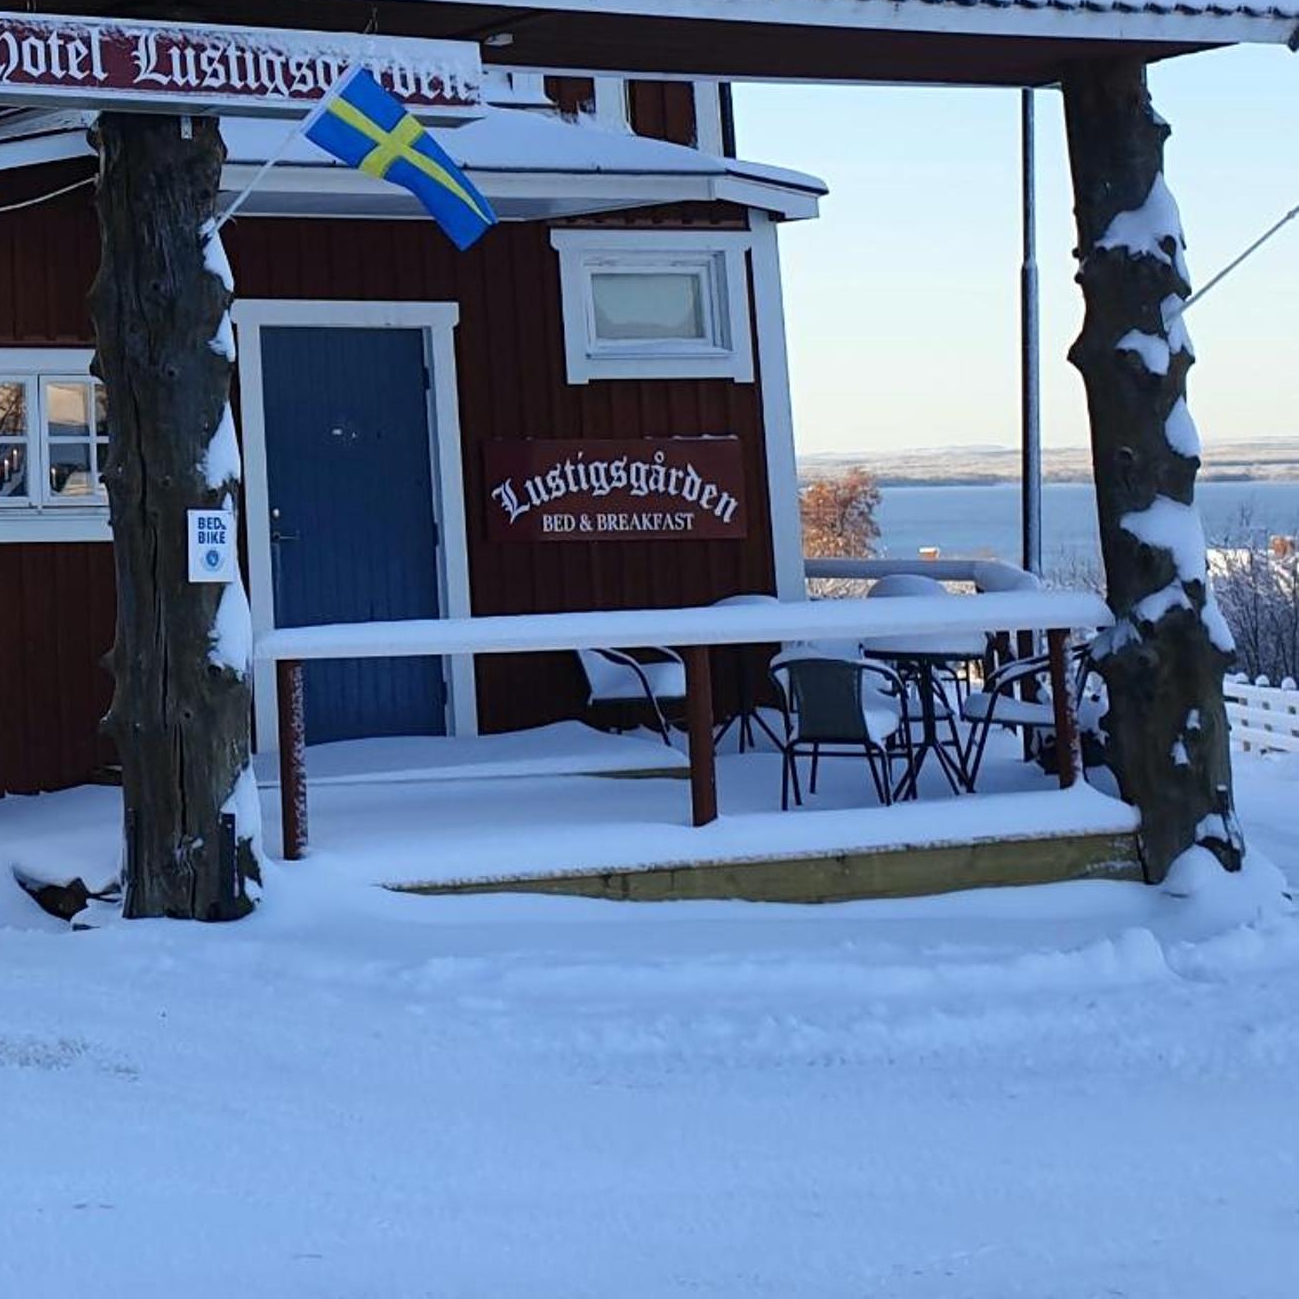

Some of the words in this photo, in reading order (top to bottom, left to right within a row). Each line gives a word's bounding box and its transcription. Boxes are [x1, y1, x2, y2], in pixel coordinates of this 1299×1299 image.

[491, 451, 739, 524] Lustigsgården
[543, 514, 576, 532] BED
[579, 514, 593, 531] &
[597, 512, 696, 532] BREAKFAST
[198, 531, 226, 545] BIKE
